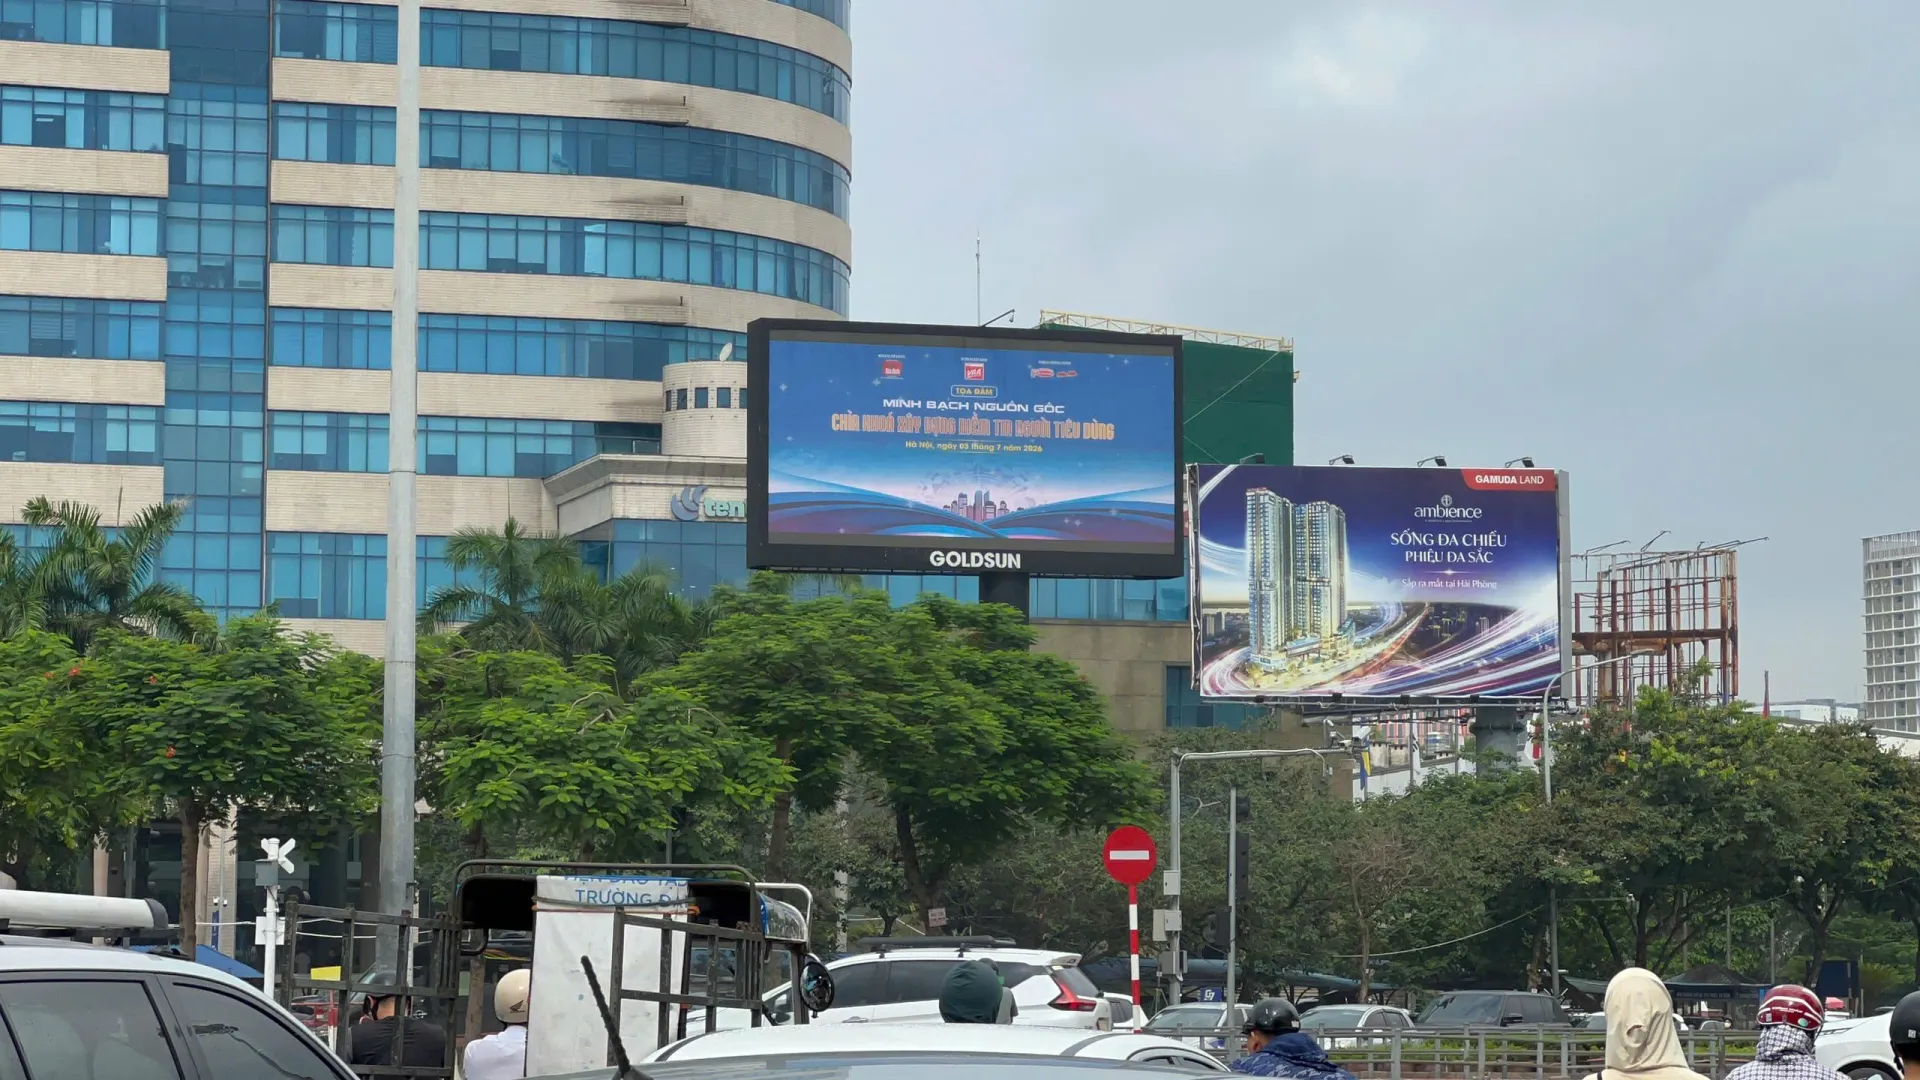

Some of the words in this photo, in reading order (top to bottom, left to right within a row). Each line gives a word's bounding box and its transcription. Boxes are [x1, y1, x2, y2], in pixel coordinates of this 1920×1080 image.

[883, 399, 922, 408] MINH
[926, 400, 969, 411] BẠCH
[897, 412, 921, 433] XÂY
[993, 419, 1013, 437] TIN
[1053, 418, 1081, 439] TIÊU
[1083, 418, 1115, 440] DÙNG
[959, 442, 969, 450] 03
[996, 443, 1002, 451] 7
[1475, 474, 1518, 484] GAMUDA
[1519, 475, 1545, 485] LAND
[1414, 504, 1483, 519] ambience
[1390, 528, 1434, 546] SỐNG
[1438, 533, 1459, 546] ĐA
[1462, 530, 1507, 547] CHIỀU
[929, 550, 1021, 569] GOLDSUN
[1447, 551, 1466, 563] ĐA
[1467, 547, 1494, 563] SẮC
[1418, 580, 1427, 588] ra
[1445, 580, 1456, 589] tại
[1457, 579, 1471, 588] Hải
[1472, 579, 1498, 589] Phòng
[575, 888, 652, 905] TRƯỜNG
